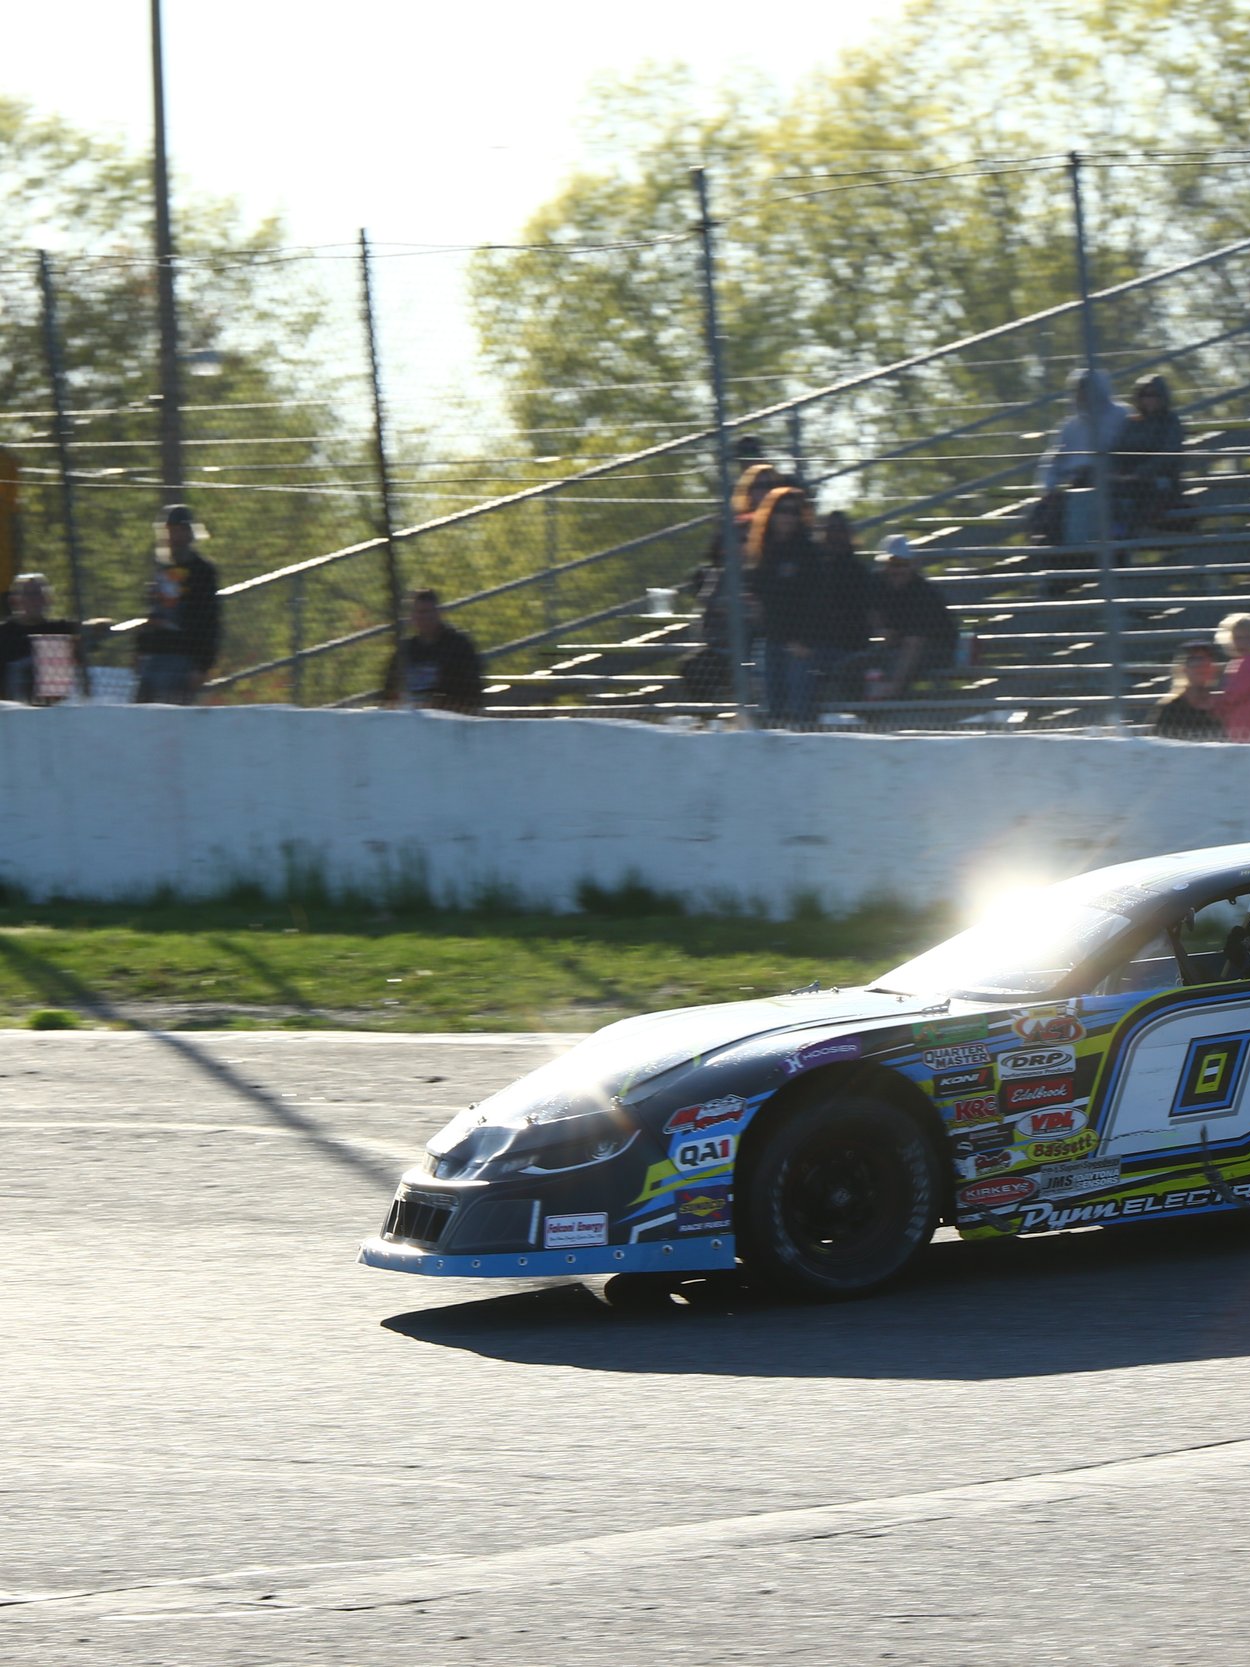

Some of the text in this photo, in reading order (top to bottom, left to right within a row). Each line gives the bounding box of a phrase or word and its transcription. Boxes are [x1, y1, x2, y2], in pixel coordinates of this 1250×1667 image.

[803, 1045, 857, 1060] HOOSIER
[925, 1045, 984, 1064] QUARTER
[1011, 1052, 1064, 1068] DRP
[936, 1054, 989, 1068] MASTER
[1011, 1084, 1068, 1102] Edelbrock
[681, 1139, 731, 1167] QA1
[1033, 1133, 1093, 1158] Bassett
[1042, 1174, 1073, 1190] JMS
[1077, 1169, 1120, 1181] DAYTONA
[1078, 1178, 1119, 1189] SENSORS
